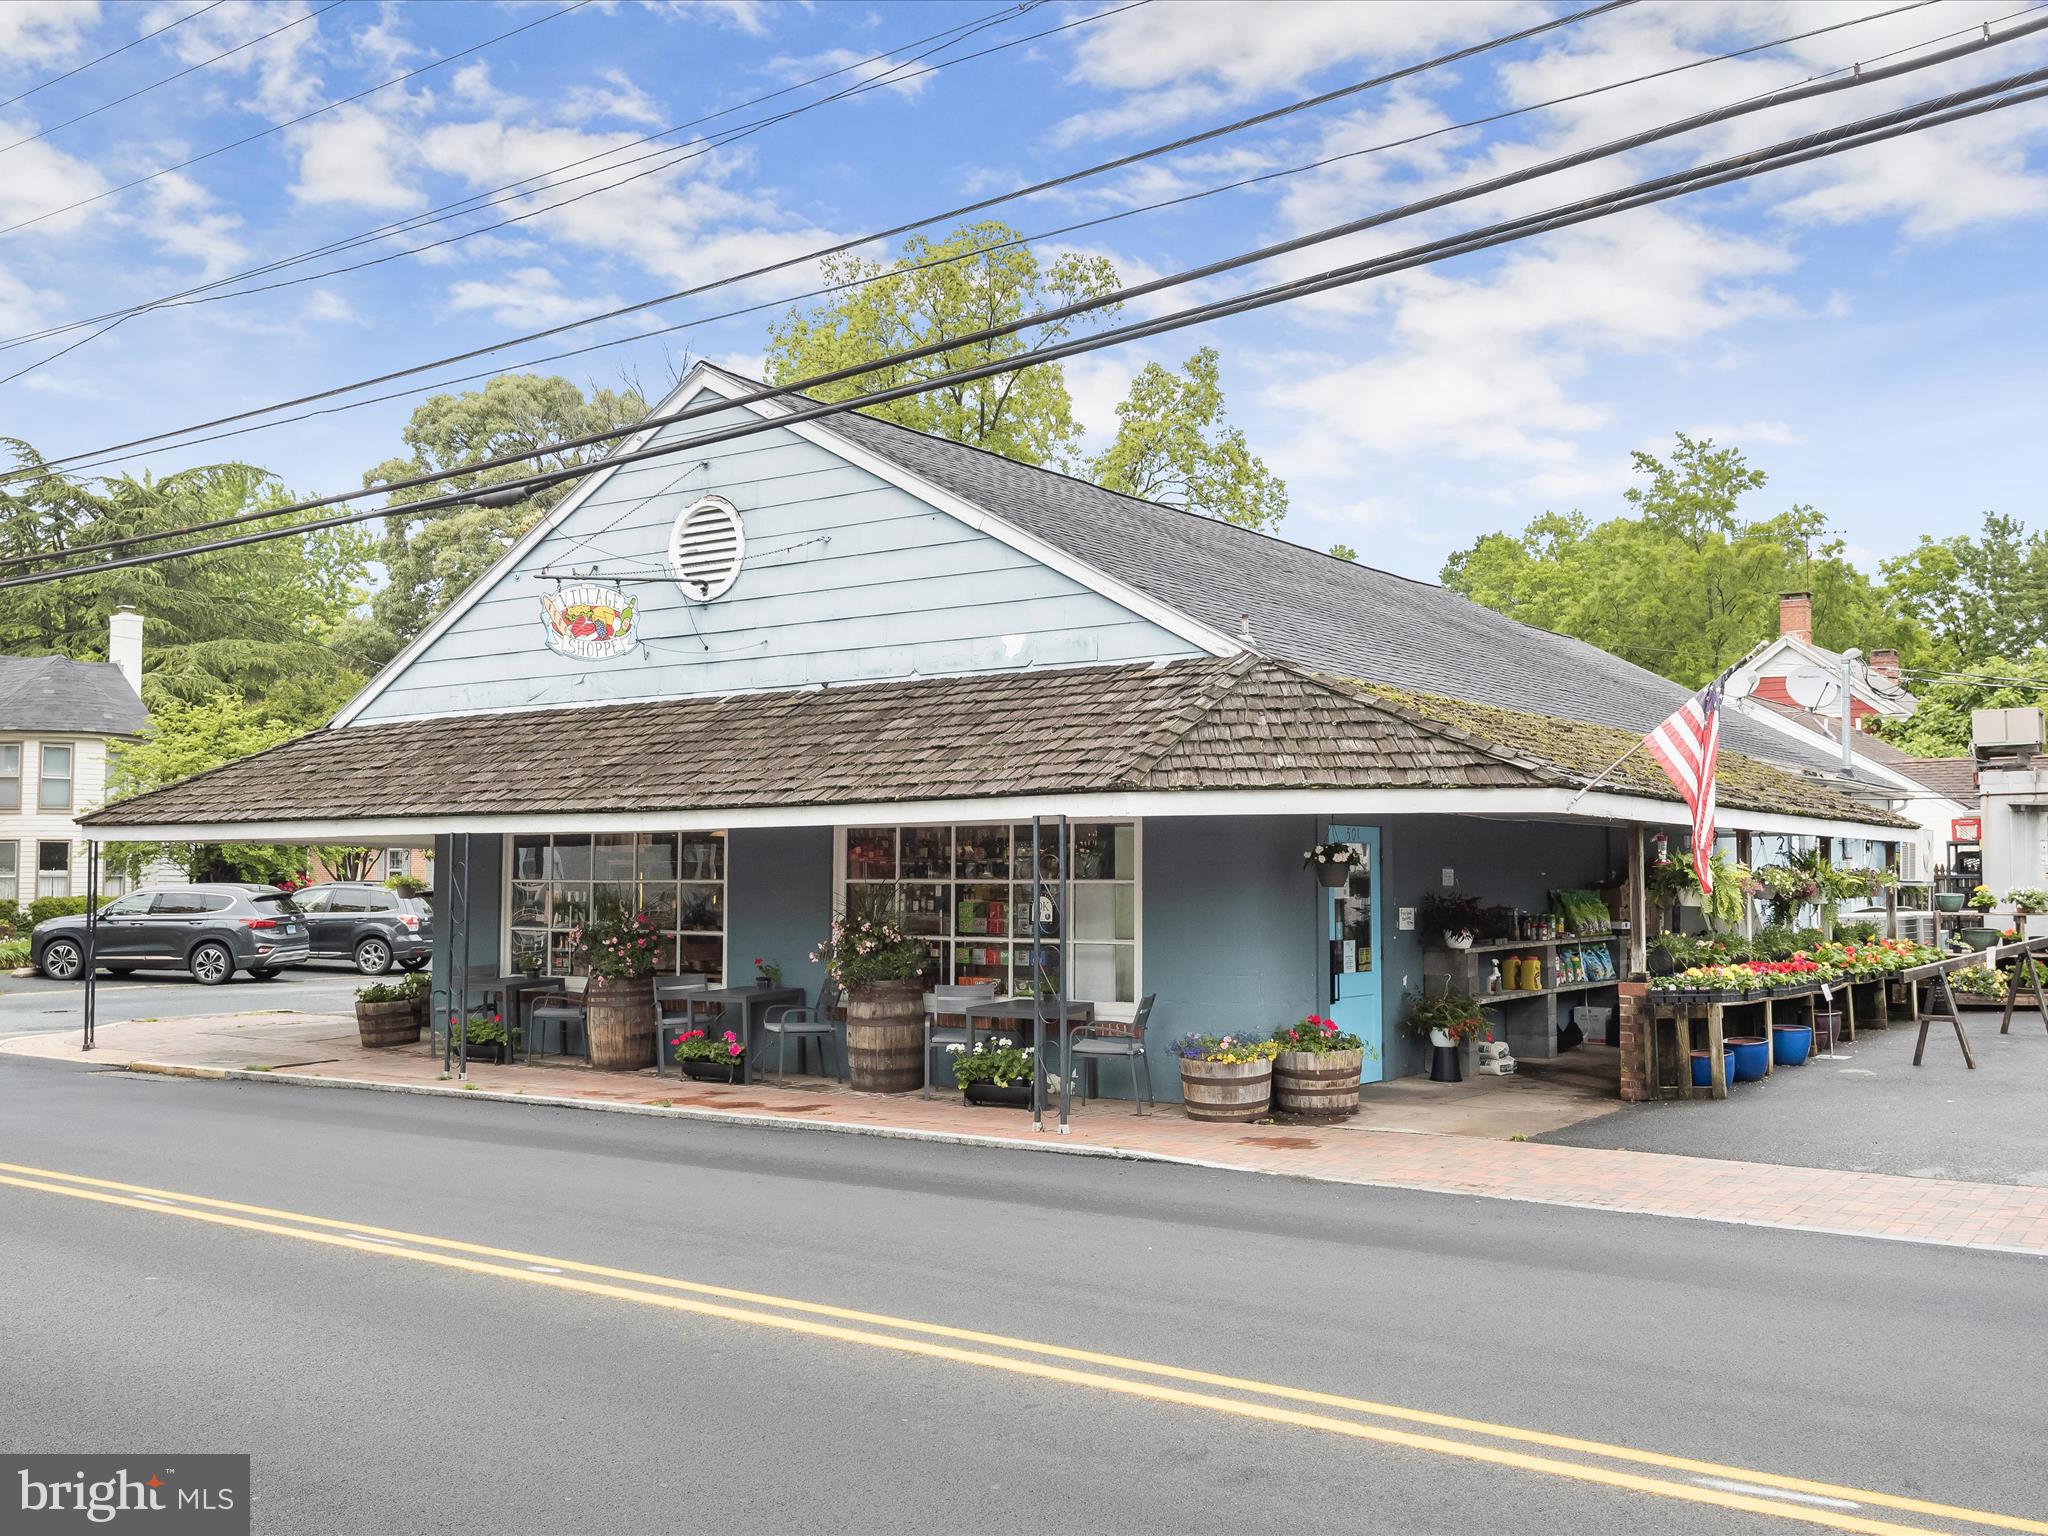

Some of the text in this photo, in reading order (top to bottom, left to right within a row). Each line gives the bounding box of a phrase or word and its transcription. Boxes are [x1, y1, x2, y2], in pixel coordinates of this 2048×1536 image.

[558, 588, 620, 610] VILLAGE
[568, 639, 619, 656] SHOPPE
[1346, 827, 1360, 841] 501
